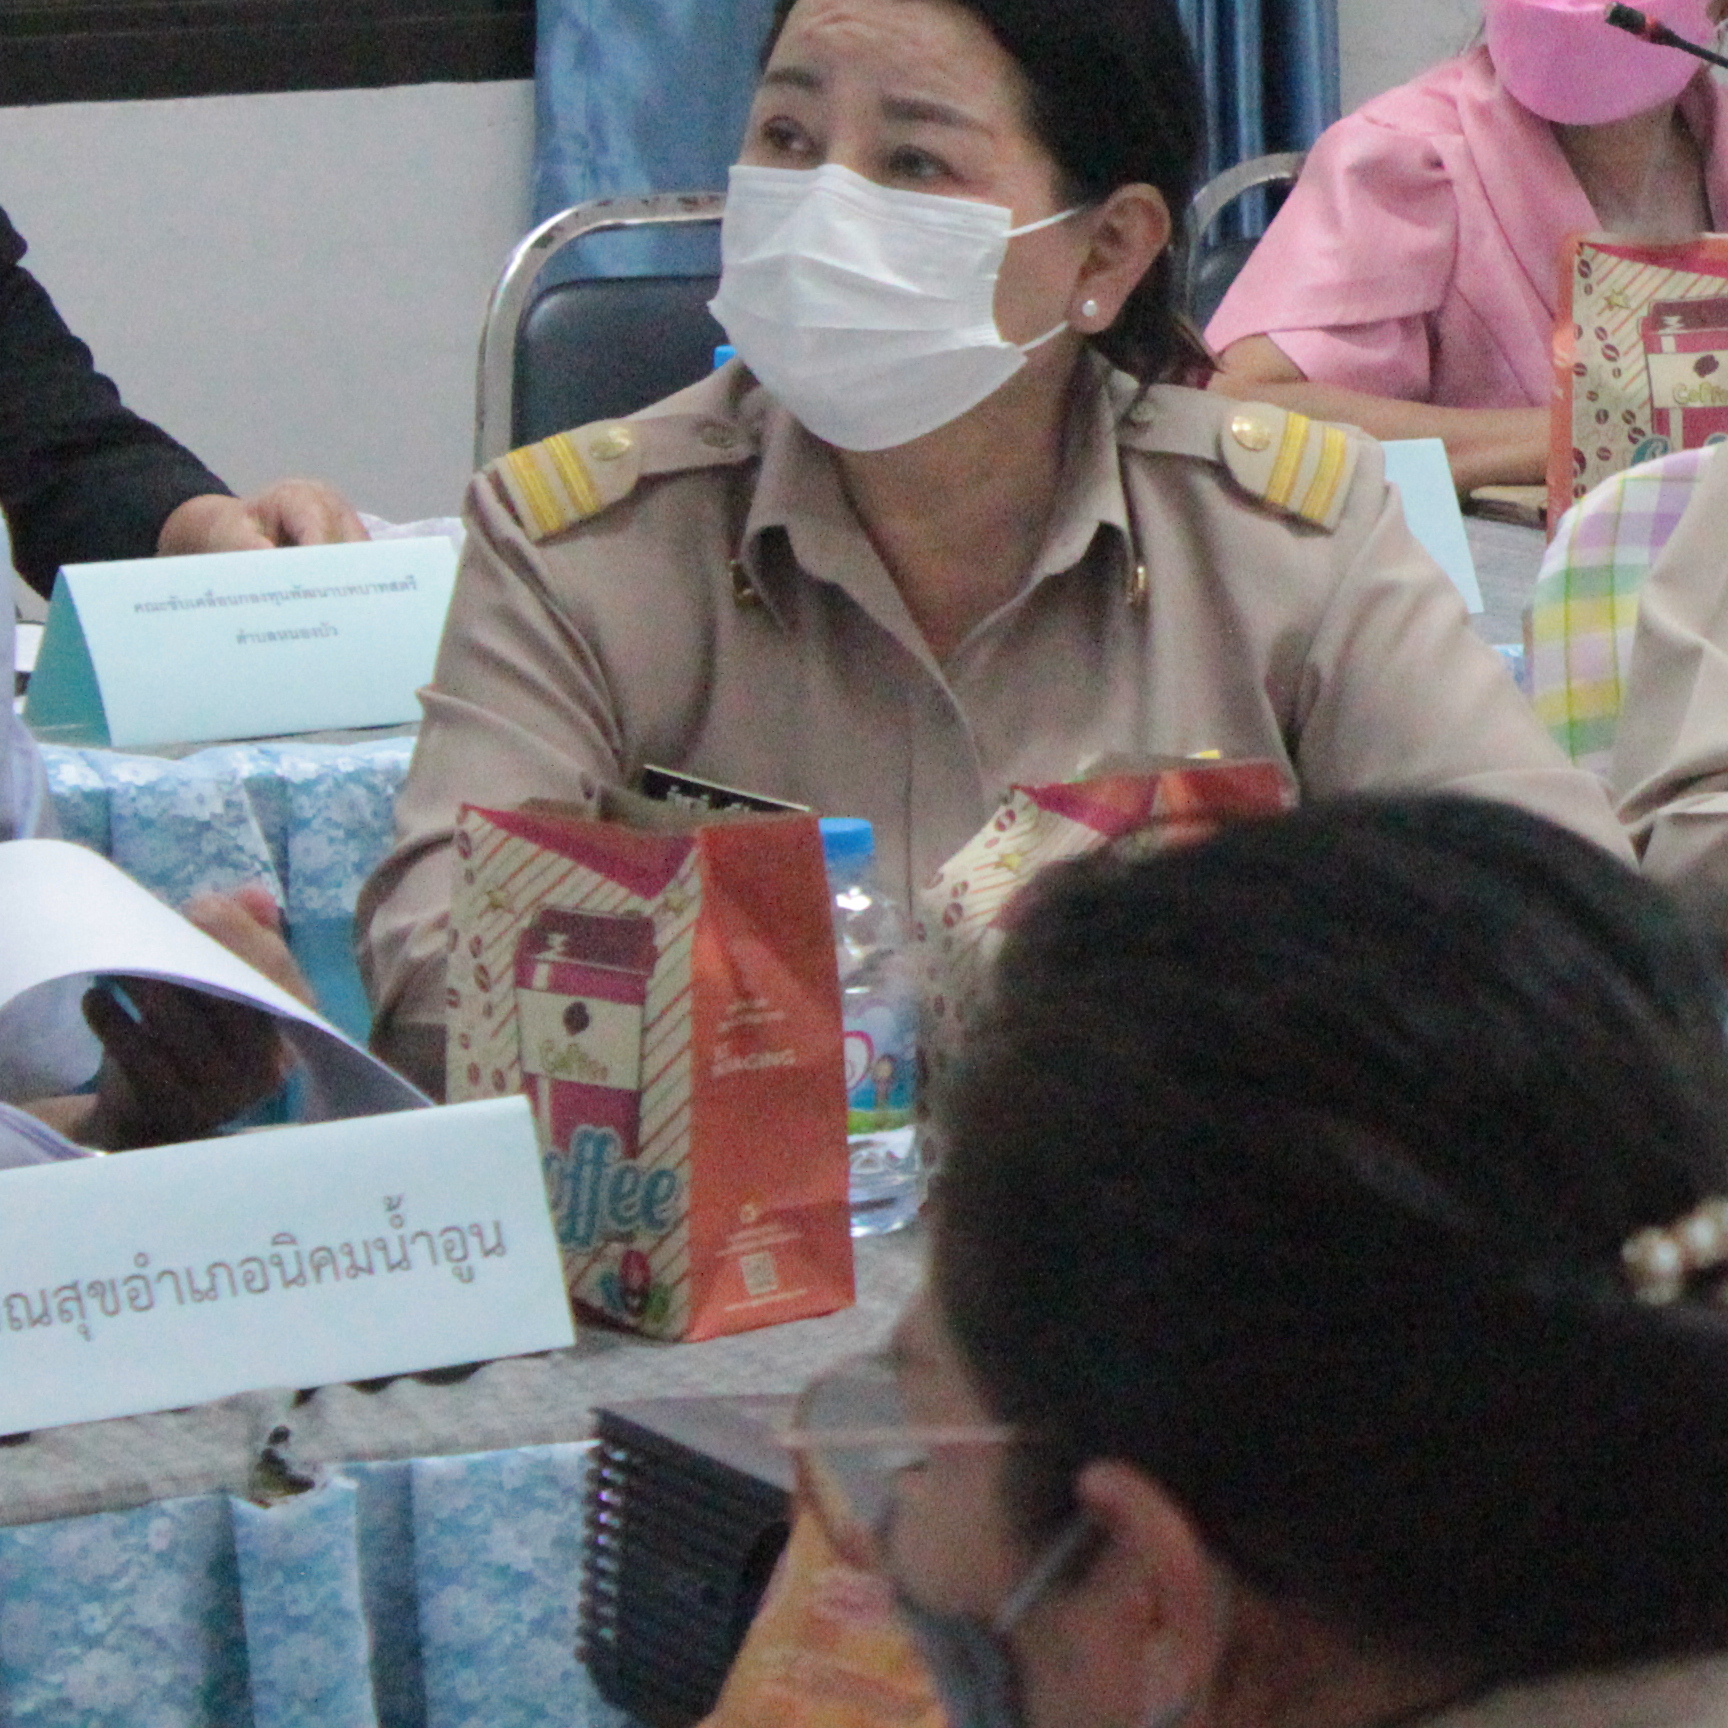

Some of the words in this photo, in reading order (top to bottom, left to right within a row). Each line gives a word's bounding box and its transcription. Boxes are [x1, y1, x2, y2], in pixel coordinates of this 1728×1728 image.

[543, 1124, 682, 1253] offee
[0, 1195, 508, 1342] ณสุขอำเภอนิคมน้ำอูน
